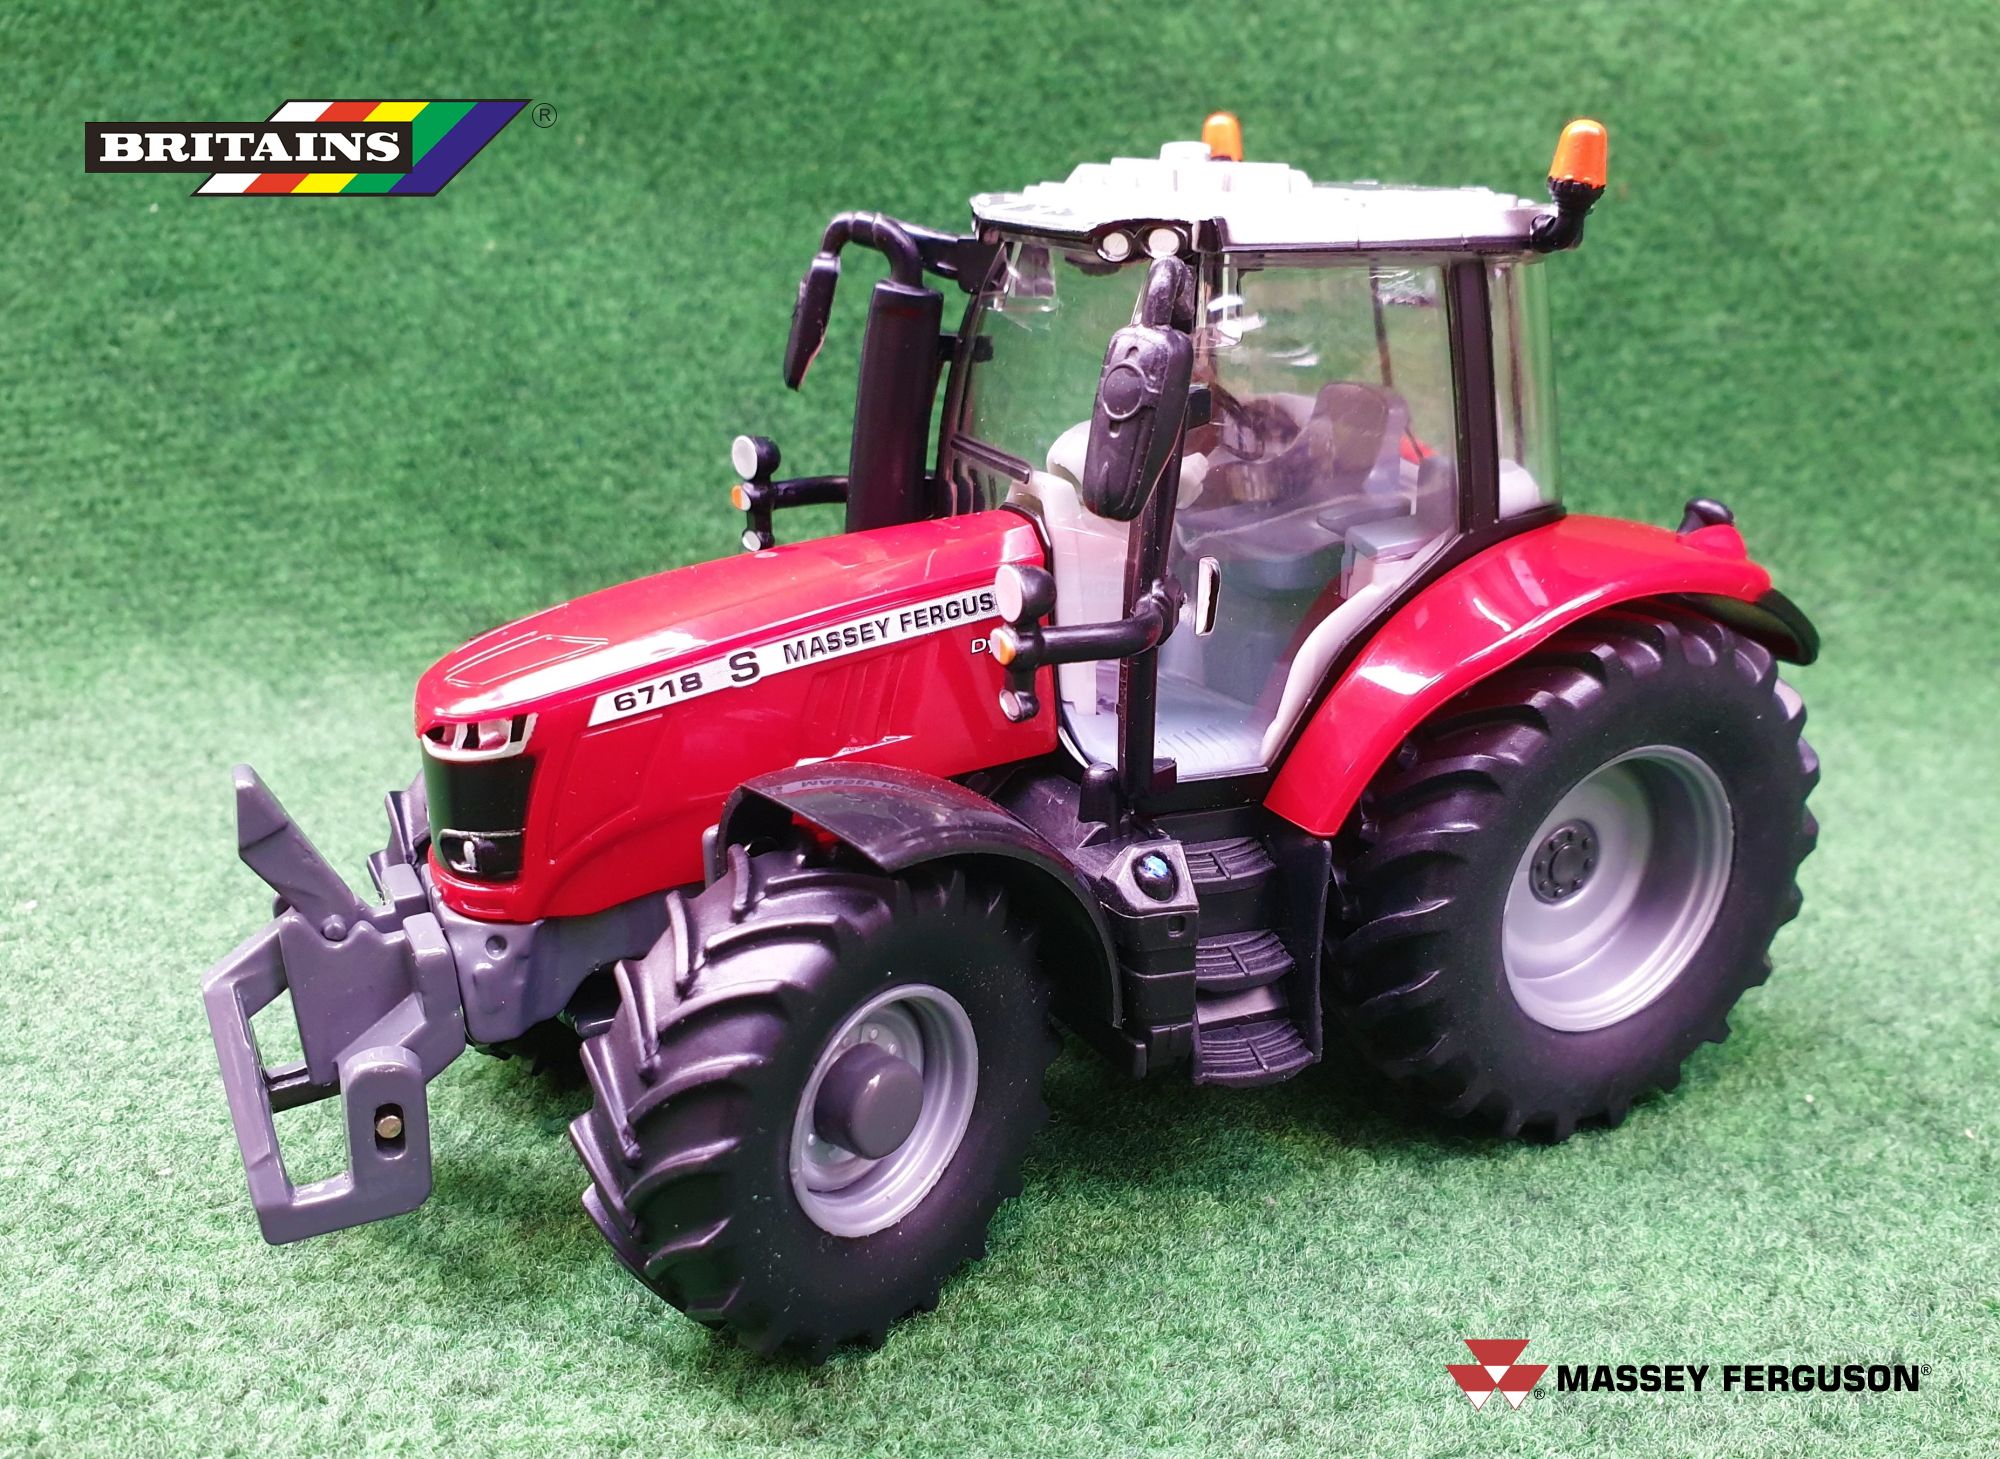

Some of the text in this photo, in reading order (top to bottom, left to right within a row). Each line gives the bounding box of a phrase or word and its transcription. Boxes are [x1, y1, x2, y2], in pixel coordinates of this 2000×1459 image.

[613, 591, 995, 712] 6718 S MASSEY FERGUS
